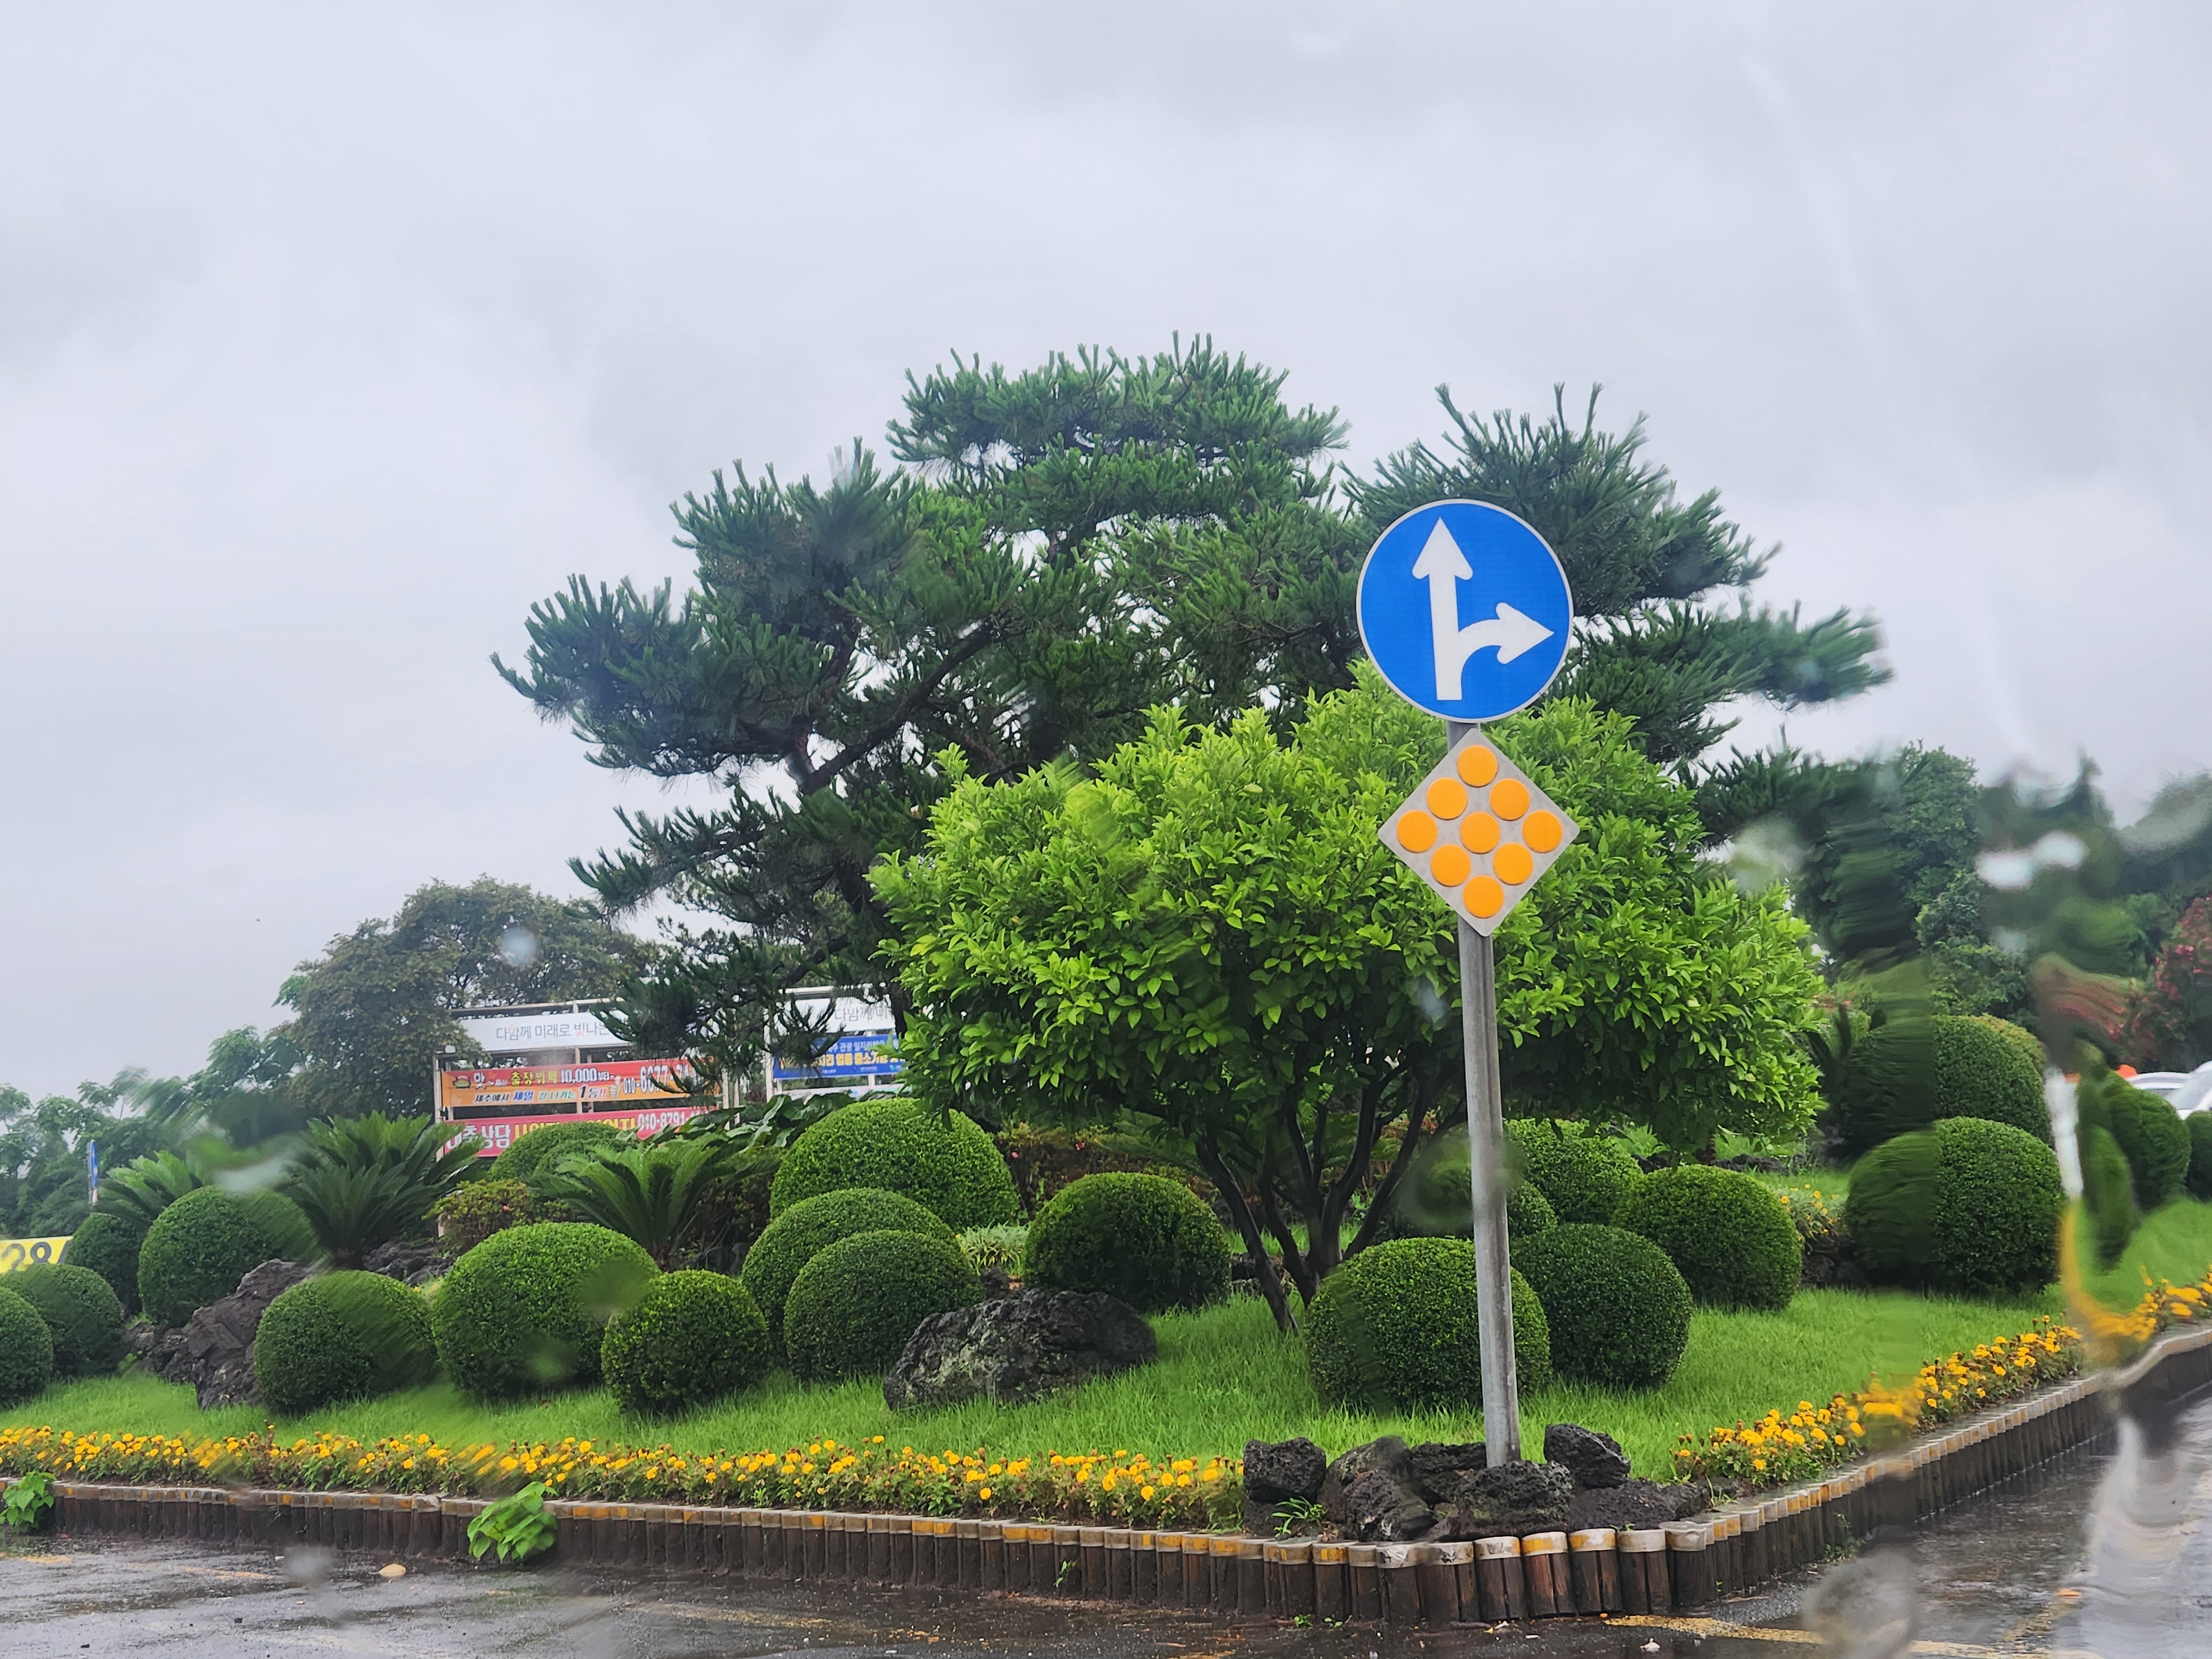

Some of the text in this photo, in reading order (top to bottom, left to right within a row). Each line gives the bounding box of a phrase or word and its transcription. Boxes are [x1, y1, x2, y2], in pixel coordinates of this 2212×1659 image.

[496, 1021, 610, 1041] 다함께 미래로 빛나는
[510, 1070, 558, 1087] 출장뷔페
[513, 1091, 534, 1102] 제일
